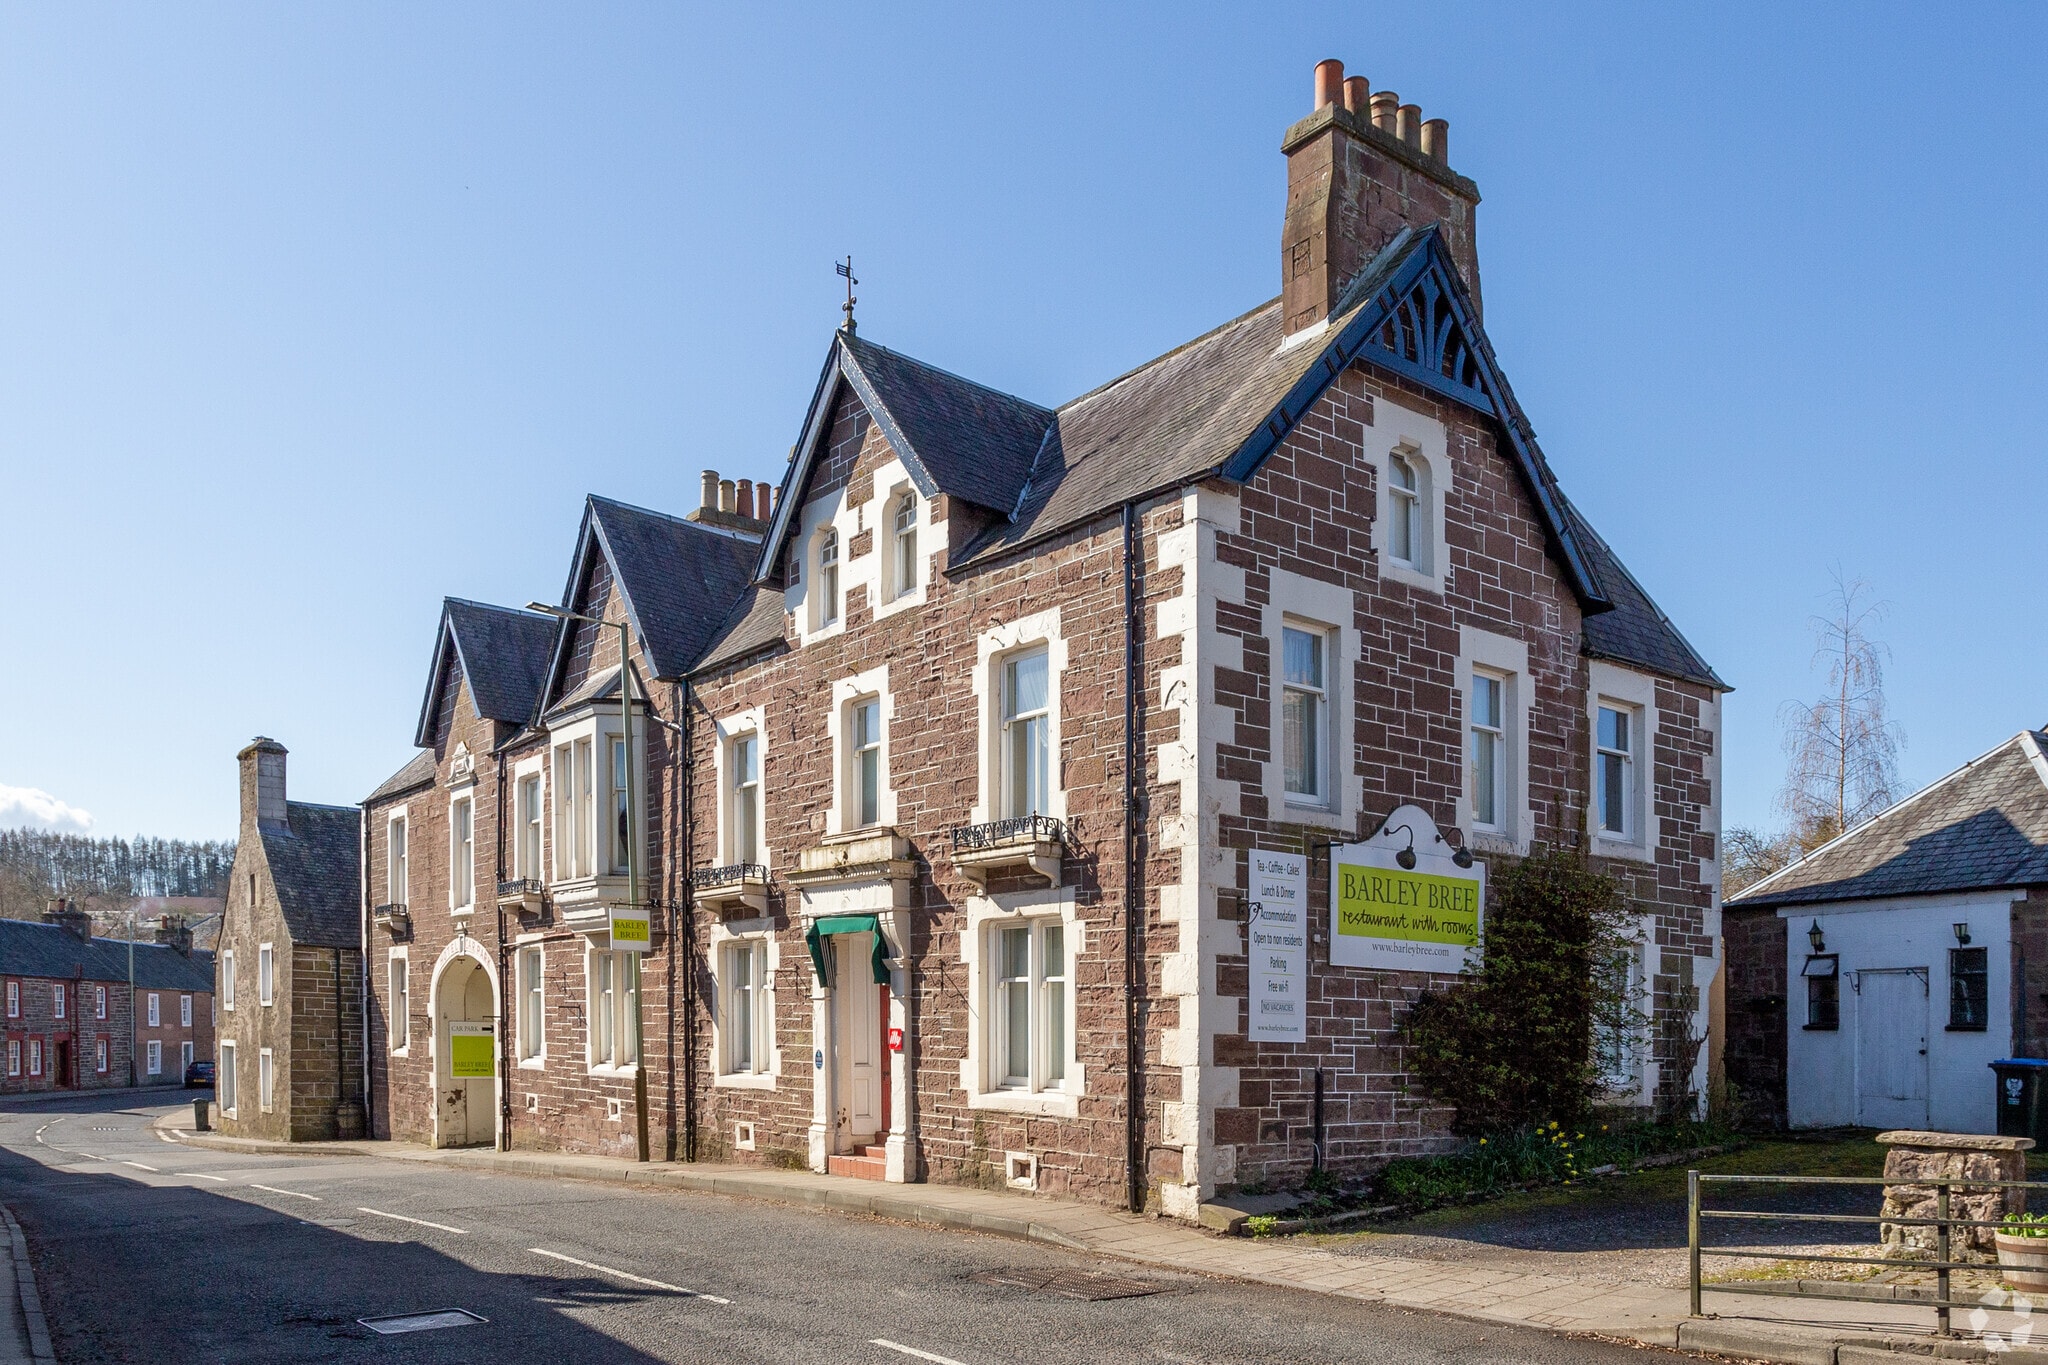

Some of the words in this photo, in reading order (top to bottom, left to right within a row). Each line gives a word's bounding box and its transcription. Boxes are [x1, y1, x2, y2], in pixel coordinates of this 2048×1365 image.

[1257, 860, 1265, 871] Tea
[1268, 861, 1283, 874] Coffee
[1286, 863, 1300, 876] Cakes
[1261, 884, 1276, 897] Lunch
[1276, 885, 1280, 897] &
[1280, 886, 1295, 898] Dinner
[1343, 873, 1422, 906] BARLEY
[1428, 883, 1474, 913] BREE
[1260, 906, 1296, 922] Accommodation
[614, 920, 647, 930] BARLEY
[1343, 909, 1409, 929] restaurant
[1412, 914, 1439, 932] with
[1441, 919, 1474, 936] rooms
[620, 931, 642, 939] BREE
[1254, 931, 1266, 946] Open
[1267, 933, 1272, 944] to
[1273, 935, 1282, 944] non
[1283, 934, 1303, 947] residents
[1372, 942, 1449, 957] www.barleybree.com
[1270, 956, 1287, 972] Parking
[1268, 980, 1278, 993] Free
[1263, 1003, 1270, 1011] NO
[1270, 1003, 1294, 1012] VACANCIES
